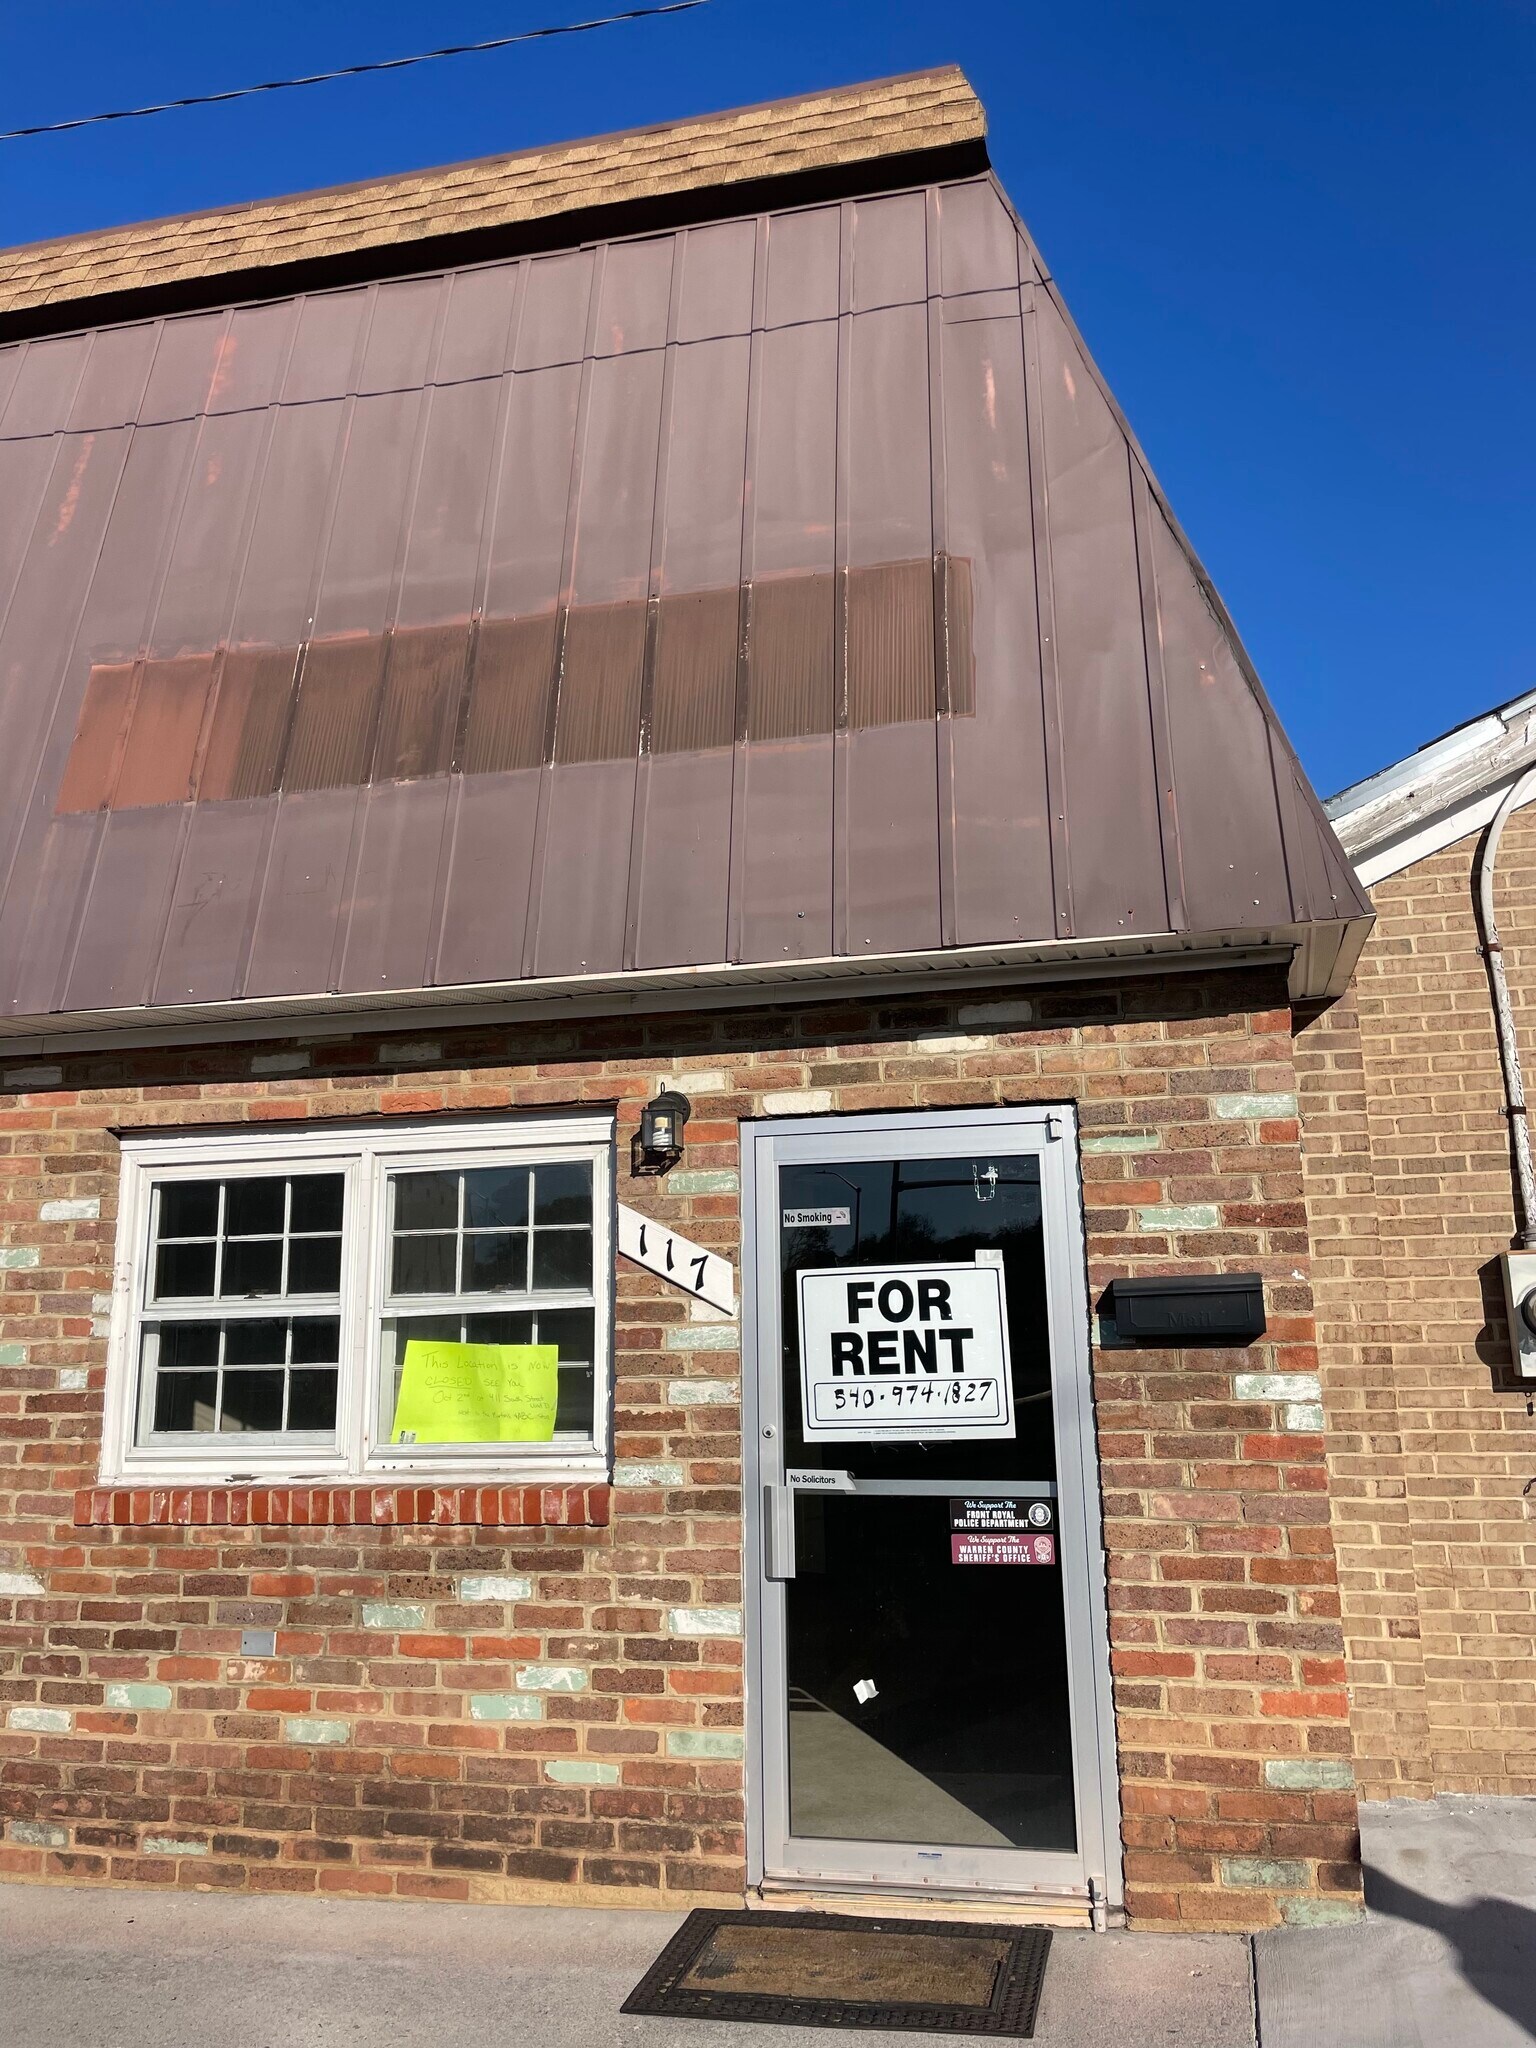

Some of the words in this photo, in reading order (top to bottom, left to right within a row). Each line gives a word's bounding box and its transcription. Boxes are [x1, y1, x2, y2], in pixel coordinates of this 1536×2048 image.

[784, 1213, 796, 1223] No
[797, 1211, 832, 1224] Smoking
[640, 1223, 709, 1291] 117
[847, 1279, 953, 1324] FOR
[830, 1328, 974, 1376] RENT
[421, 1350, 449, 1369] This
[457, 1355, 498, 1370] Location
[507, 1362, 519, 1370] is
[424, 1375, 473, 1387] CLOSED
[483, 1378, 501, 1387] SEE
[432, 1390, 452, 1404] Oct
[790, 1474, 801, 1483] No
[801, 1474, 836, 1485] Solicitors
[964, 1501, 977, 1509] We
[977, 1501, 1004, 1511] Support
[1004, 1501, 1017, 1509] The
[966, 1510, 990, 1519] FRONT
[992, 1510, 1016, 1519] ROYAL
[954, 1519, 979, 1527] POLICE
[981, 1519, 1029, 1528] DEPARTMENT
[967, 1535, 980, 1543] We
[980, 1535, 1007, 1545] Support
[1007, 1535, 1020, 1543] The
[959, 1545, 994, 1554] WARREN
[996, 1545, 1029, 1554] COUNTY
[958, 1553, 999, 1562] SHERIFF'S
[1002, 1553, 1031, 1562] OFFICE
